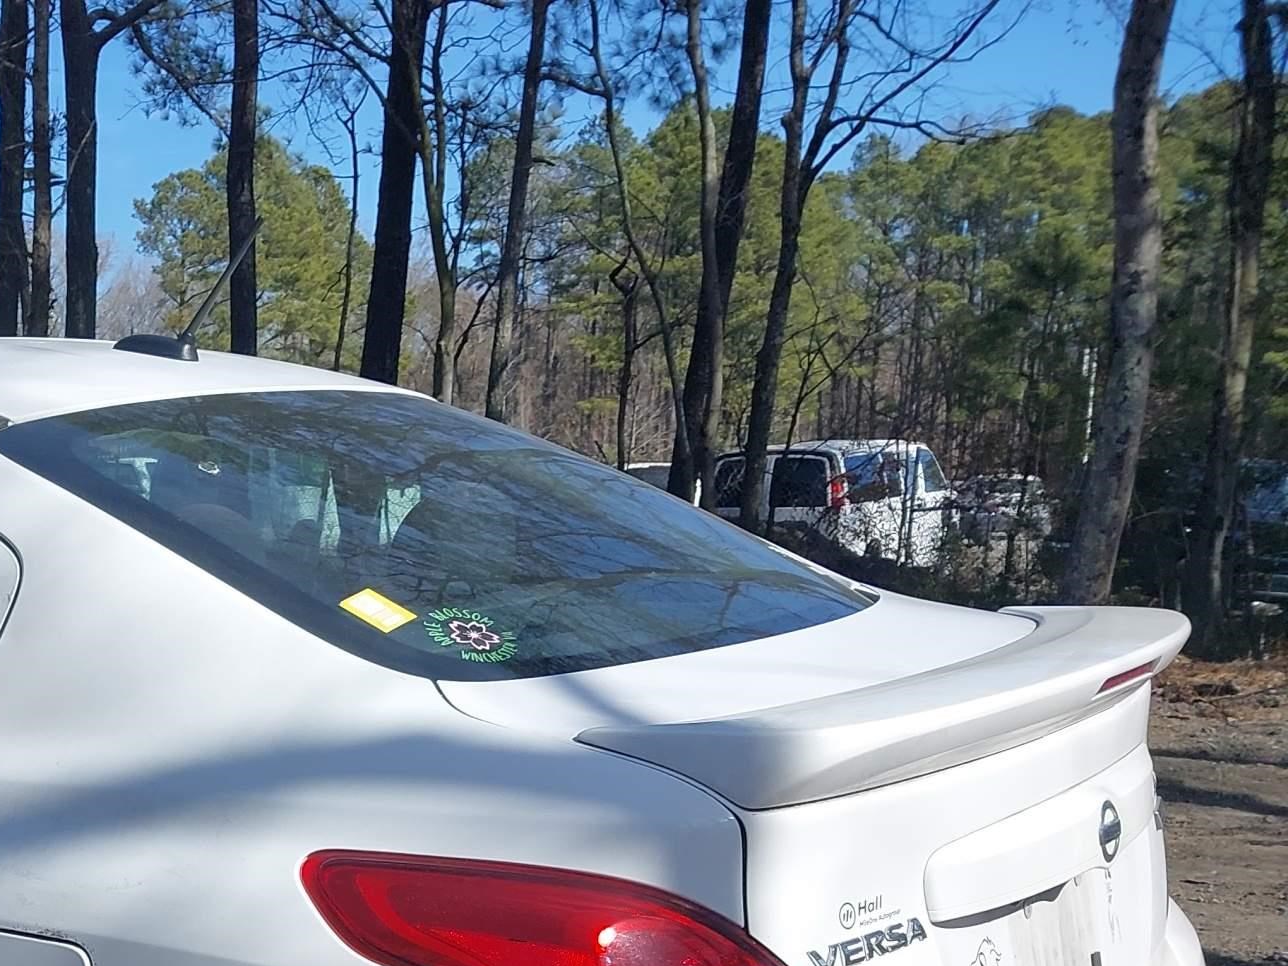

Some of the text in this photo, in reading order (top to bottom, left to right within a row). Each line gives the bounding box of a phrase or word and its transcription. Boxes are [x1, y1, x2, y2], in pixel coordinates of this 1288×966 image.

[428, 607, 494, 627] BLOSSOM
[423, 620, 455, 646] APPLE
[460, 641, 518, 663] WINCHESTER
[857, 894, 883, 917] Hall
